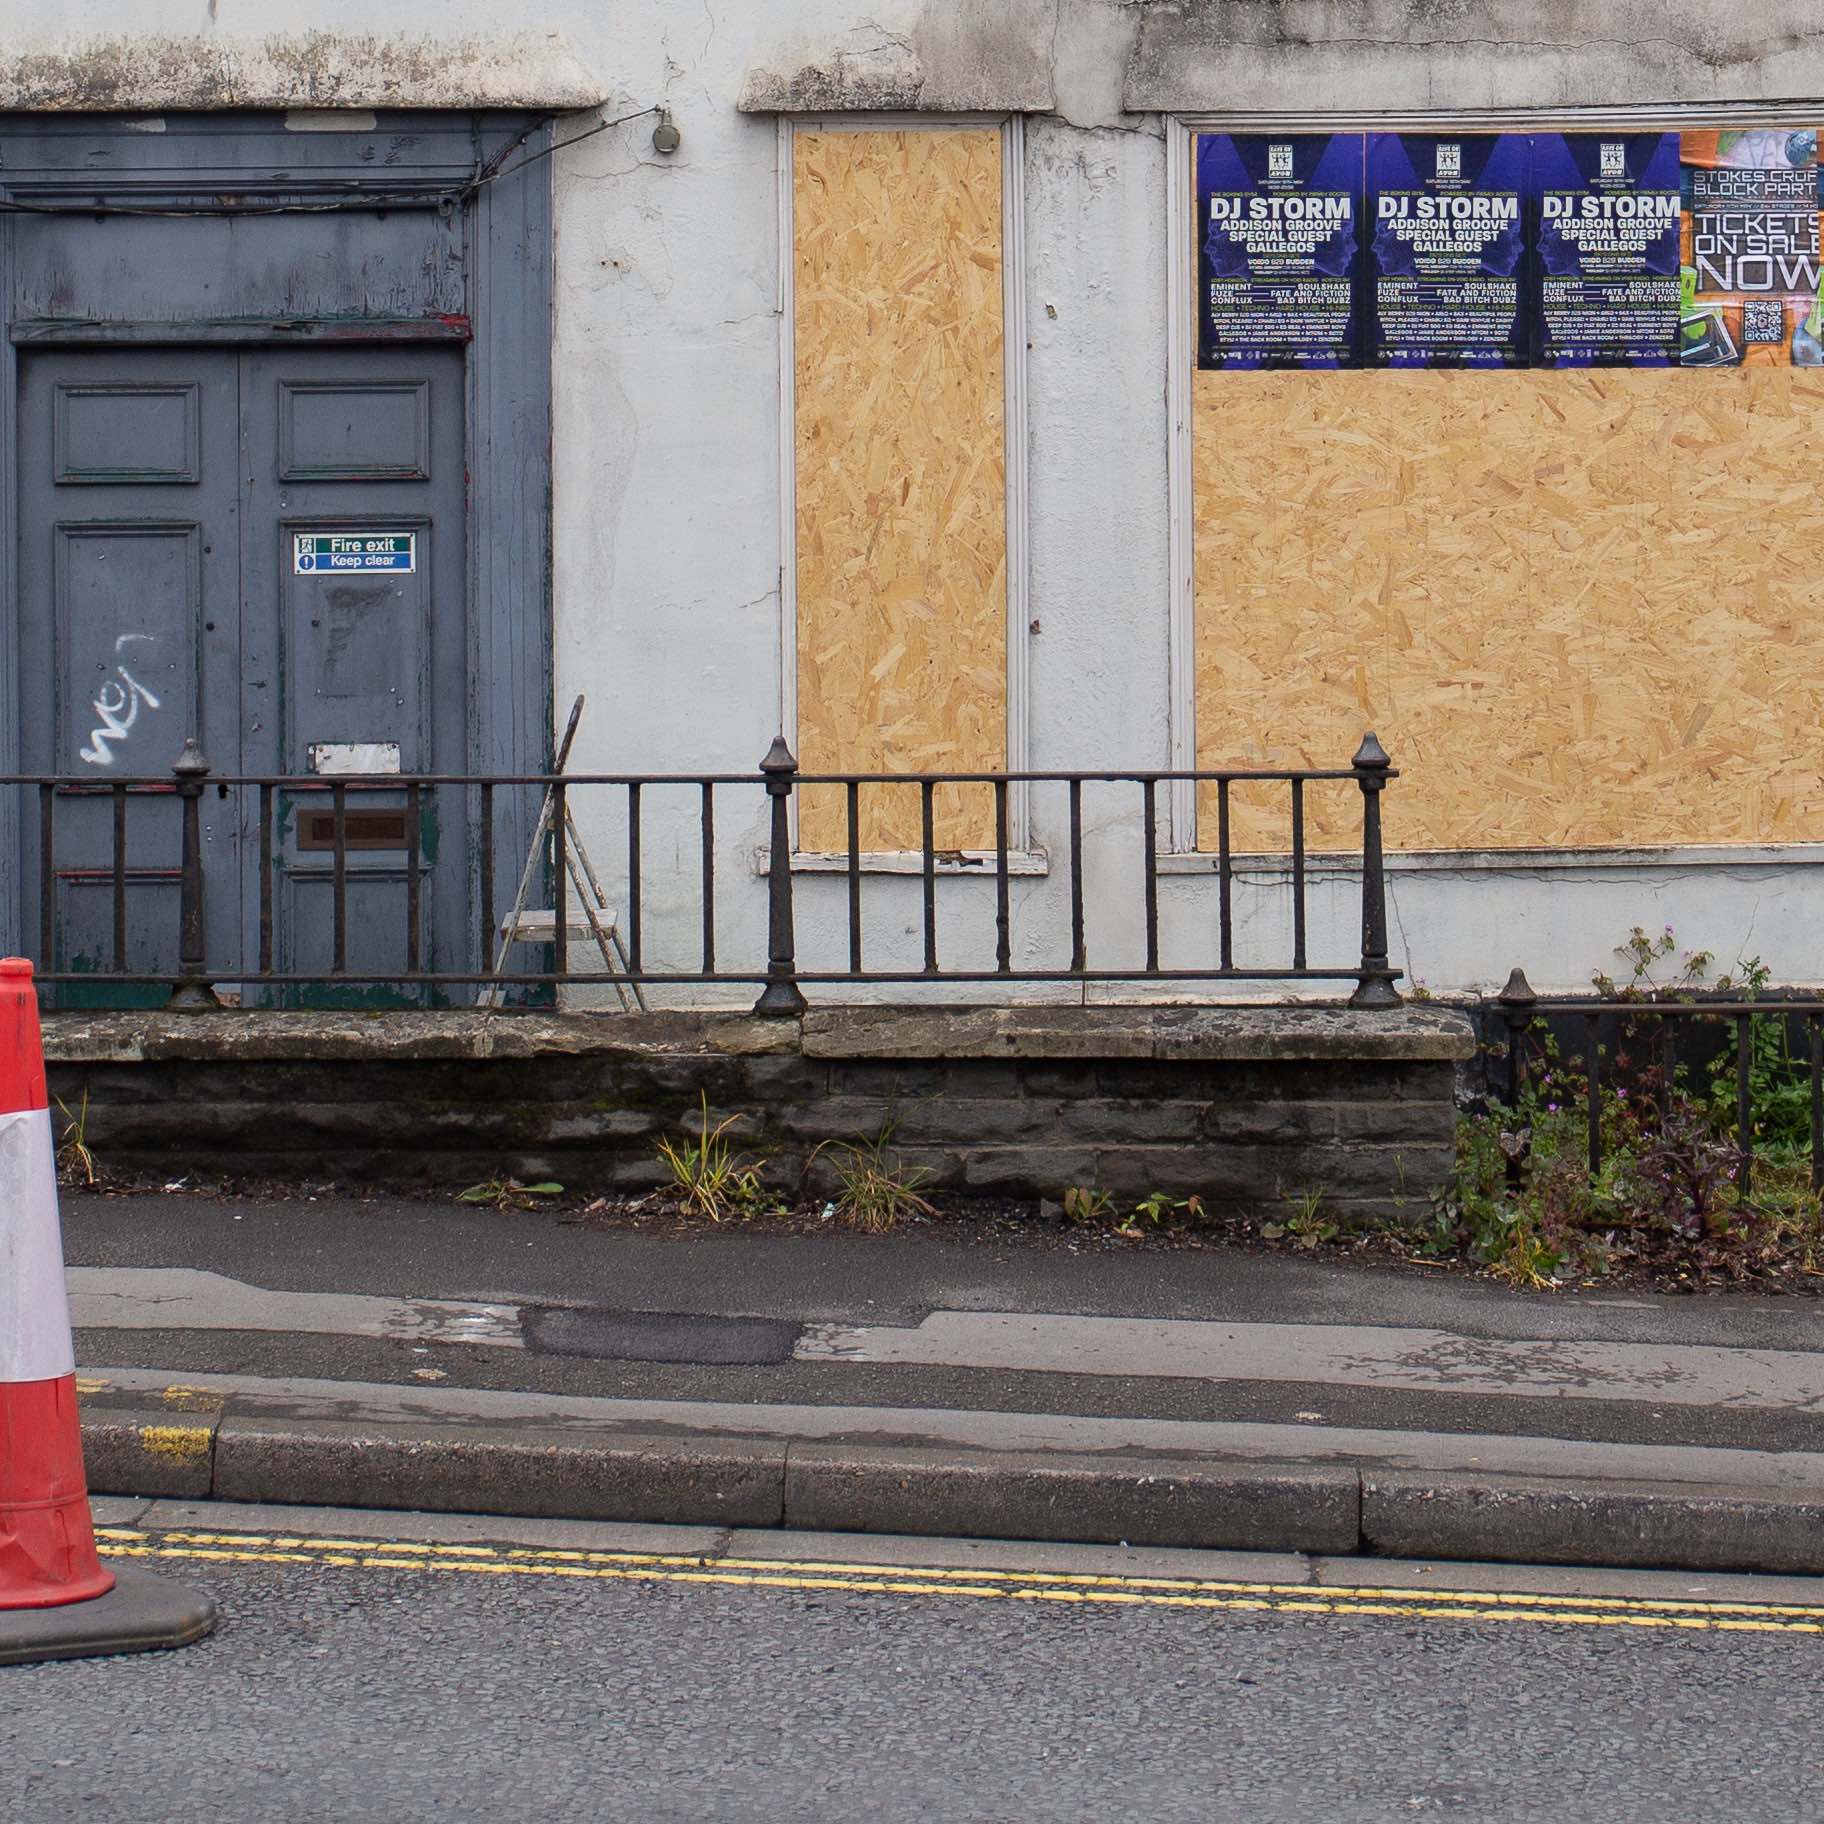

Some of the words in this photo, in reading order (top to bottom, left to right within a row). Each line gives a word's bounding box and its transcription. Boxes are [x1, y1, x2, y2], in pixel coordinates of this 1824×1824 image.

[1694, 171, 1764, 182] STOKES
[1770, 170, 1817, 182] CROF
[1694, 183, 1758, 195] BLOCK
[1765, 183, 1816, 195] PART
[1211, 198, 1241, 219] DJ
[1249, 198, 1350, 219] STORM
[1379, 197, 1408, 218] DJ
[1417, 197, 1517, 218] STORM
[1544, 197, 1573, 218] DJ
[1581, 196, 1680, 218] STORM
[1220, 220, 1281, 230] ADDISON
[1286, 220, 1341, 230] GROOVE
[1388, 219, 1448, 230] ADDISON
[1453, 219, 1508, 230] GROOVE
[1553, 219, 1613, 229] ADDISON
[1617, 218, 1672, 229] GROOVE
[1694, 214, 1819, 234] TICKETS
[1229, 231, 1285, 241] SPECIAL
[1288, 231, 1332, 241] GUEST
[1397, 230, 1452, 240] SPECIAL
[1455, 230, 1499, 241] GUEST
[1562, 230, 1616, 240] SPECIAL
[1620, 230, 1663, 240] GUEST
[1246, 242, 1315, 252] GALLEGOS
[1413, 241, 1482, 252] GALLEGOS
[1578, 241, 1646, 251] GALLEGOS
[1695, 235, 1737, 254] ON
[1747, 235, 1820, 254] SALE
[1696, 255, 1820, 290] NOW
[332, 539, 362, 552] Fire
[366, 538, 395, 552] exit
[331, 554, 362, 568] Keep
[366, 554, 395, 566] clear
